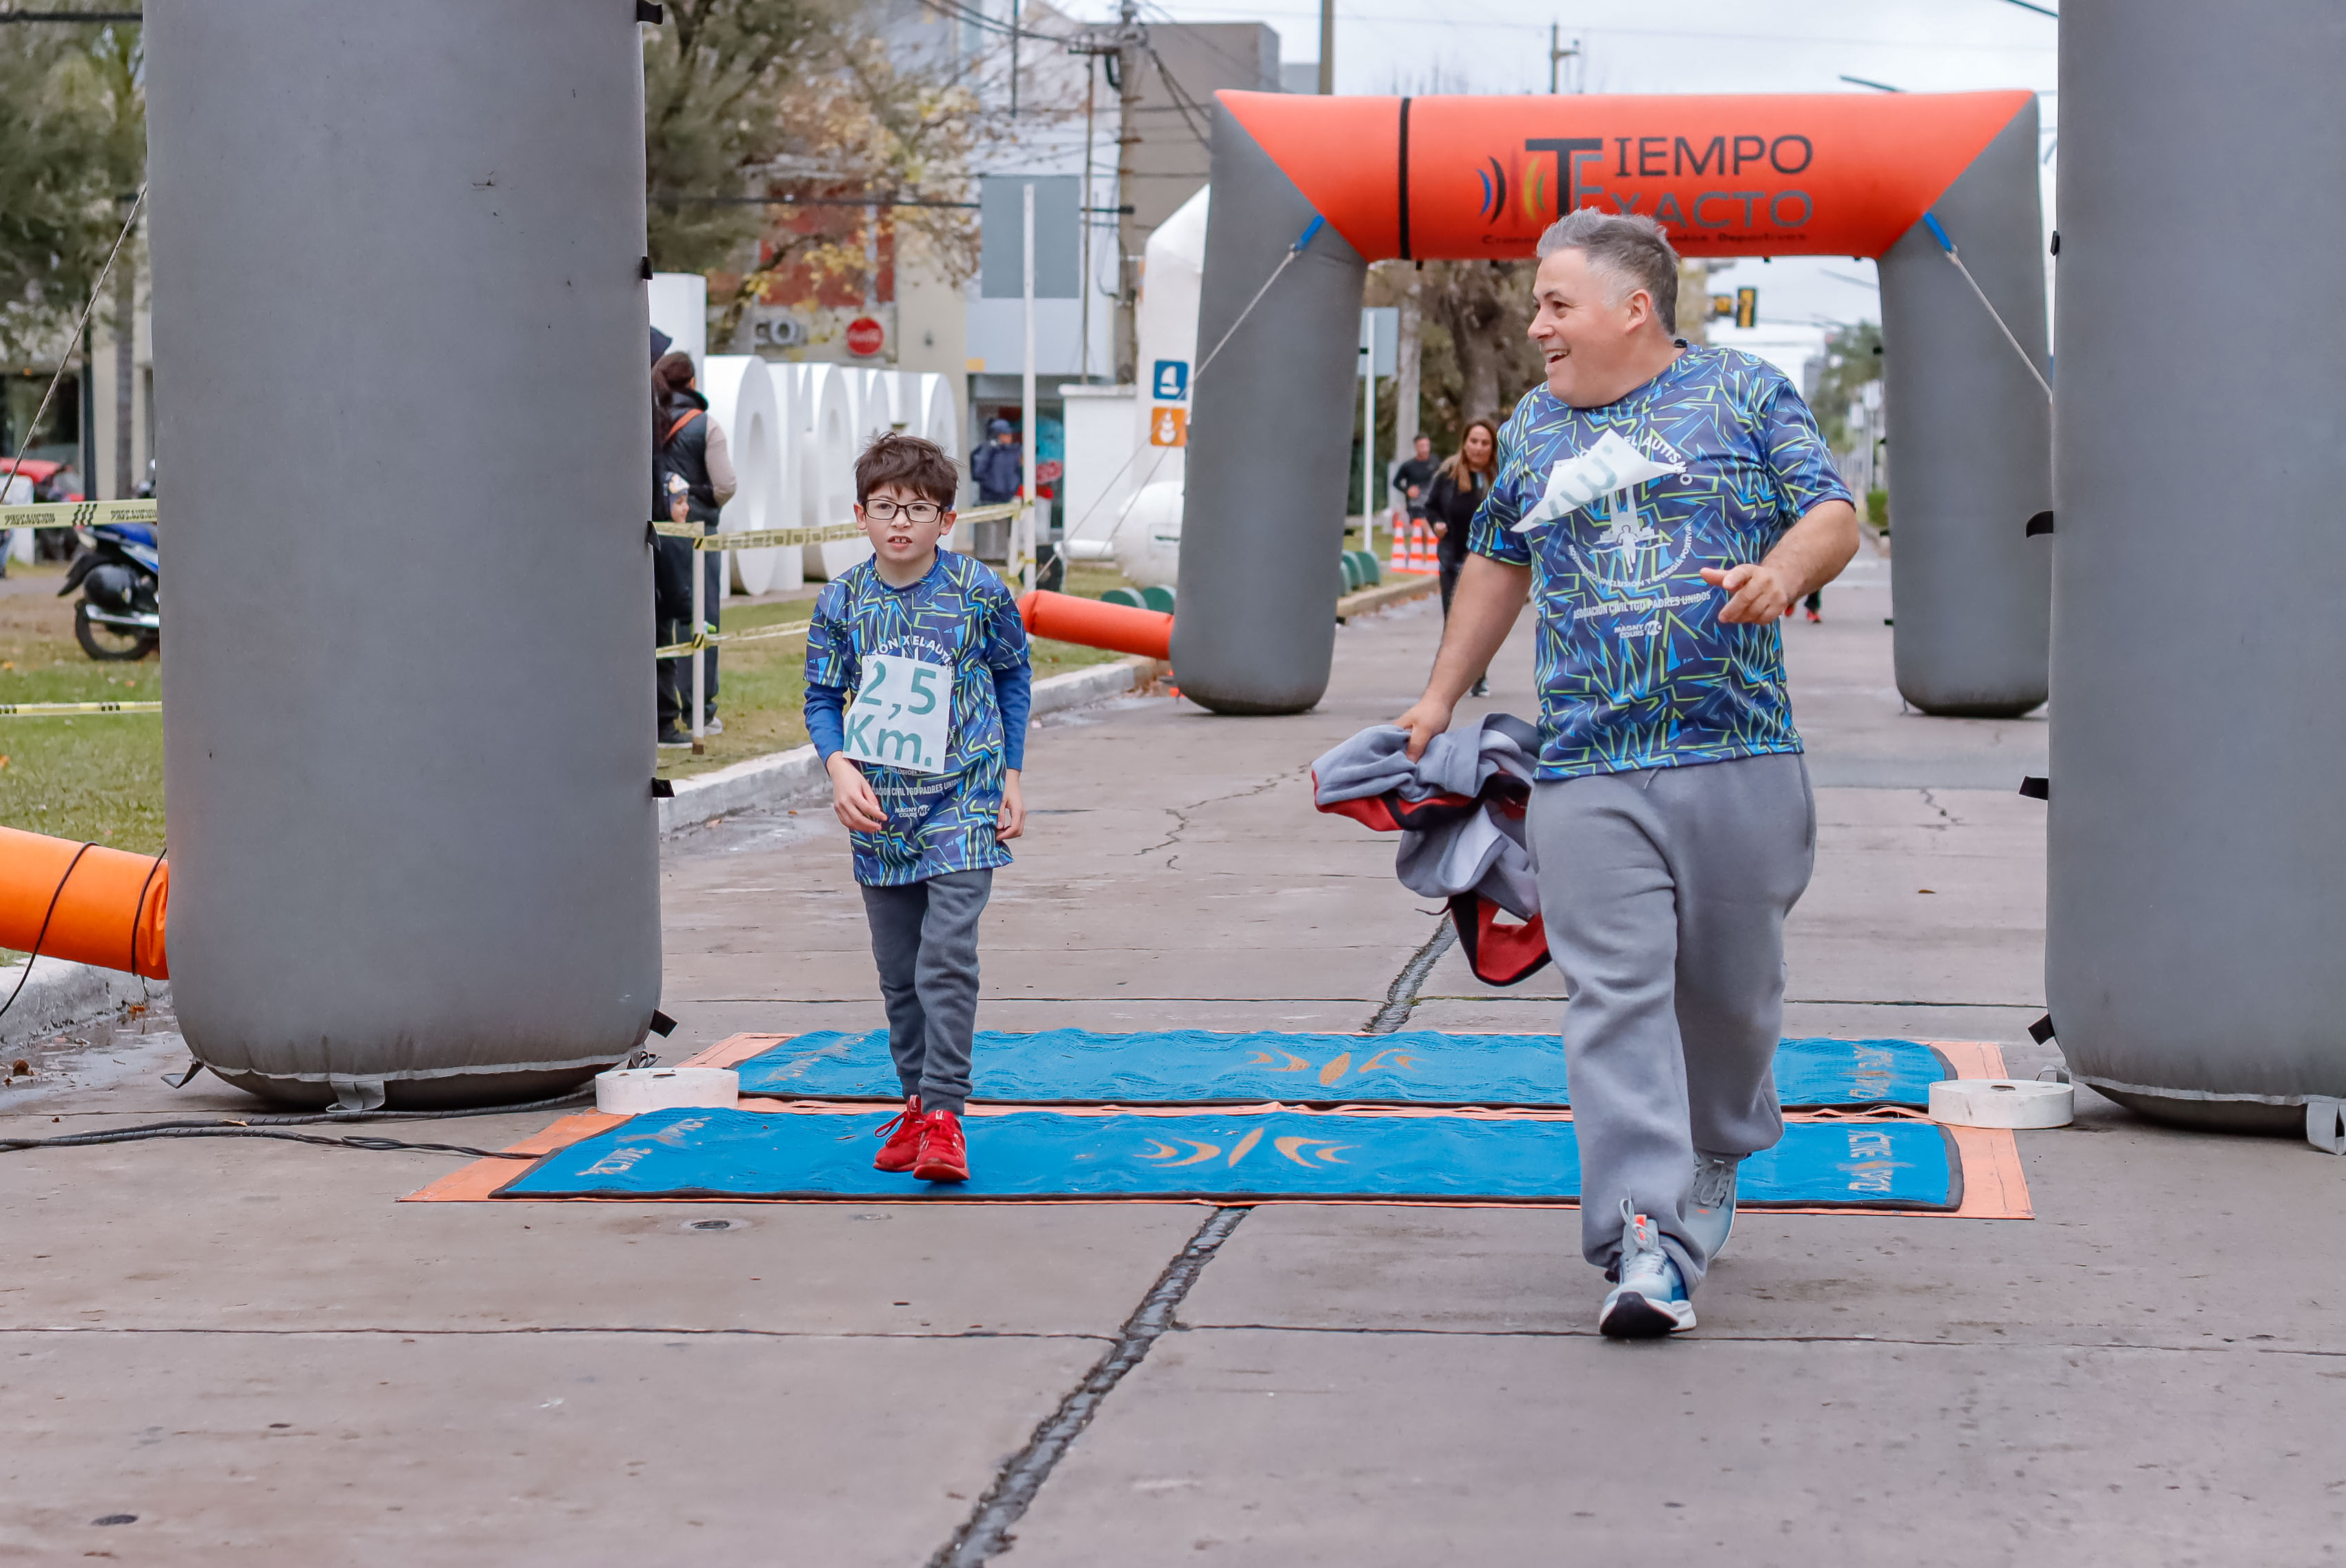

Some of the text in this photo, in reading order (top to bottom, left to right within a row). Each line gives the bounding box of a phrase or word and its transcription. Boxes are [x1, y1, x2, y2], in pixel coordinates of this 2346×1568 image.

[1679, 525, 1693, 560] POSITIVA
[1609, 602, 1629, 614] CIVIL
[1629, 599, 1646, 611] TGD
[1648, 596, 1680, 609] PADRES
[1682, 591, 1711, 606] UNIDOS
[1614, 624, 1644, 634] MAGNY
[1619, 630, 1645, 639] COURS
[859, 660, 937, 720] 2,5
[844, 713, 933, 767] Km.
[906, 787, 918, 796] TGD
[919, 783, 943, 795] PADRES
